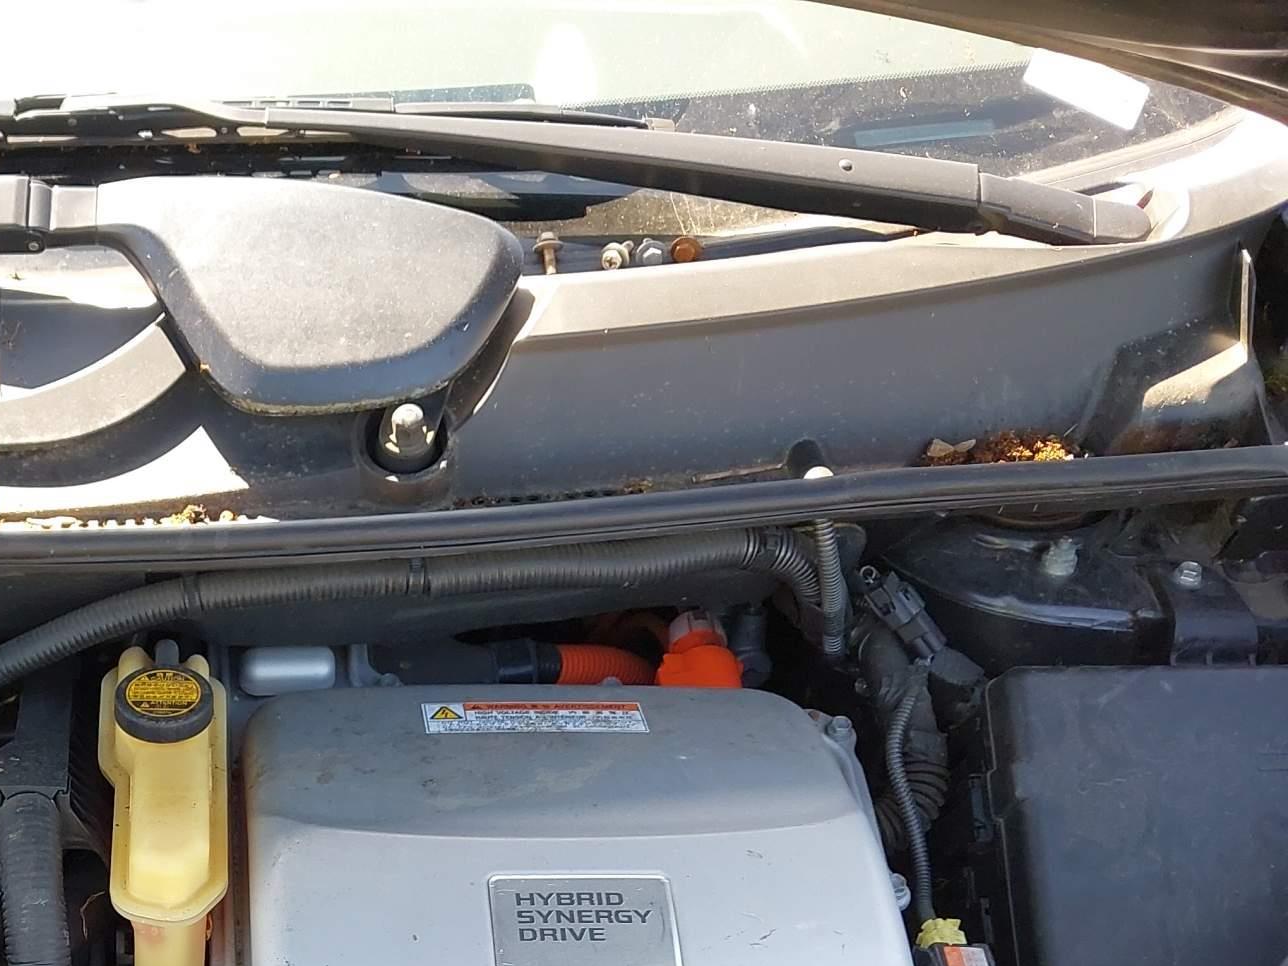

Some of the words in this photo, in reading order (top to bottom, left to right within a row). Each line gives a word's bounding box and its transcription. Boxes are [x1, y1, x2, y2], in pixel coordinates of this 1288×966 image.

[515, 892, 624, 906] HYBRID
[517, 909, 652, 924] SYNERGY
[518, 927, 606, 942] DRIVE
